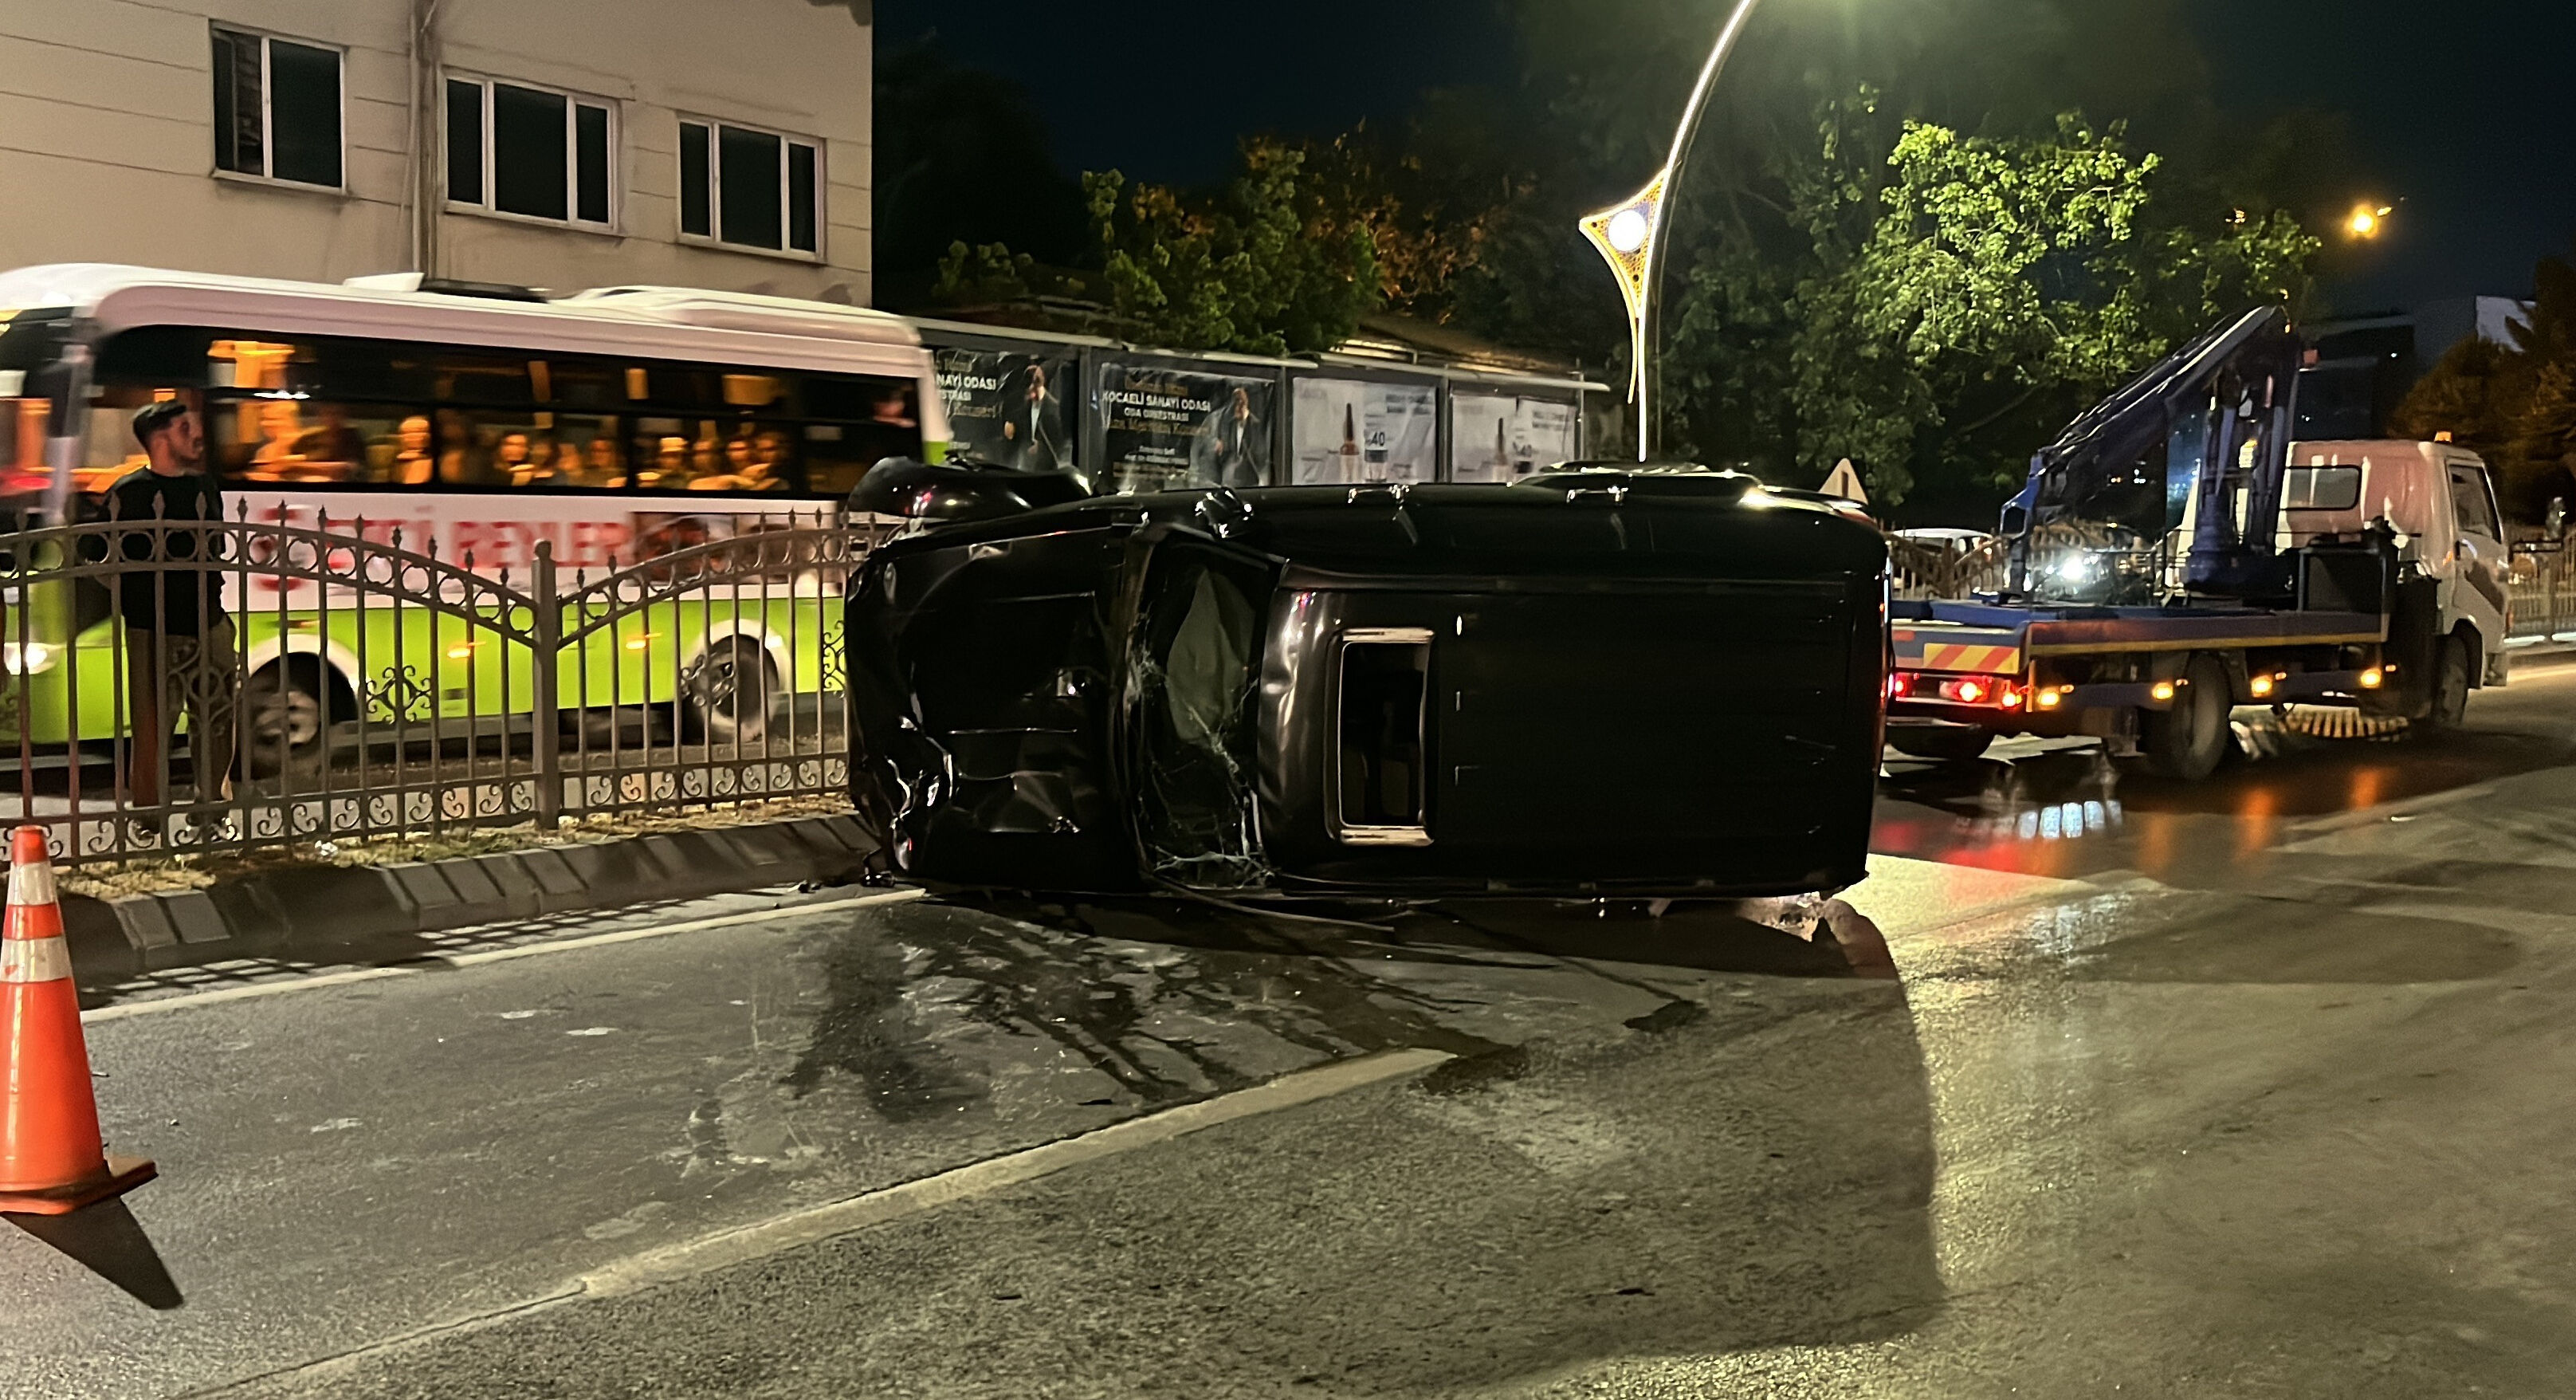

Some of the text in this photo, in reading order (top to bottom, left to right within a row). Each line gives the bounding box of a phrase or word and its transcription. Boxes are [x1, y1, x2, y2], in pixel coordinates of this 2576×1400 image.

[963, 376, 996, 391] ODASI
[1101, 390, 1211, 412] KOCAELİ SANAYİ ODASI
